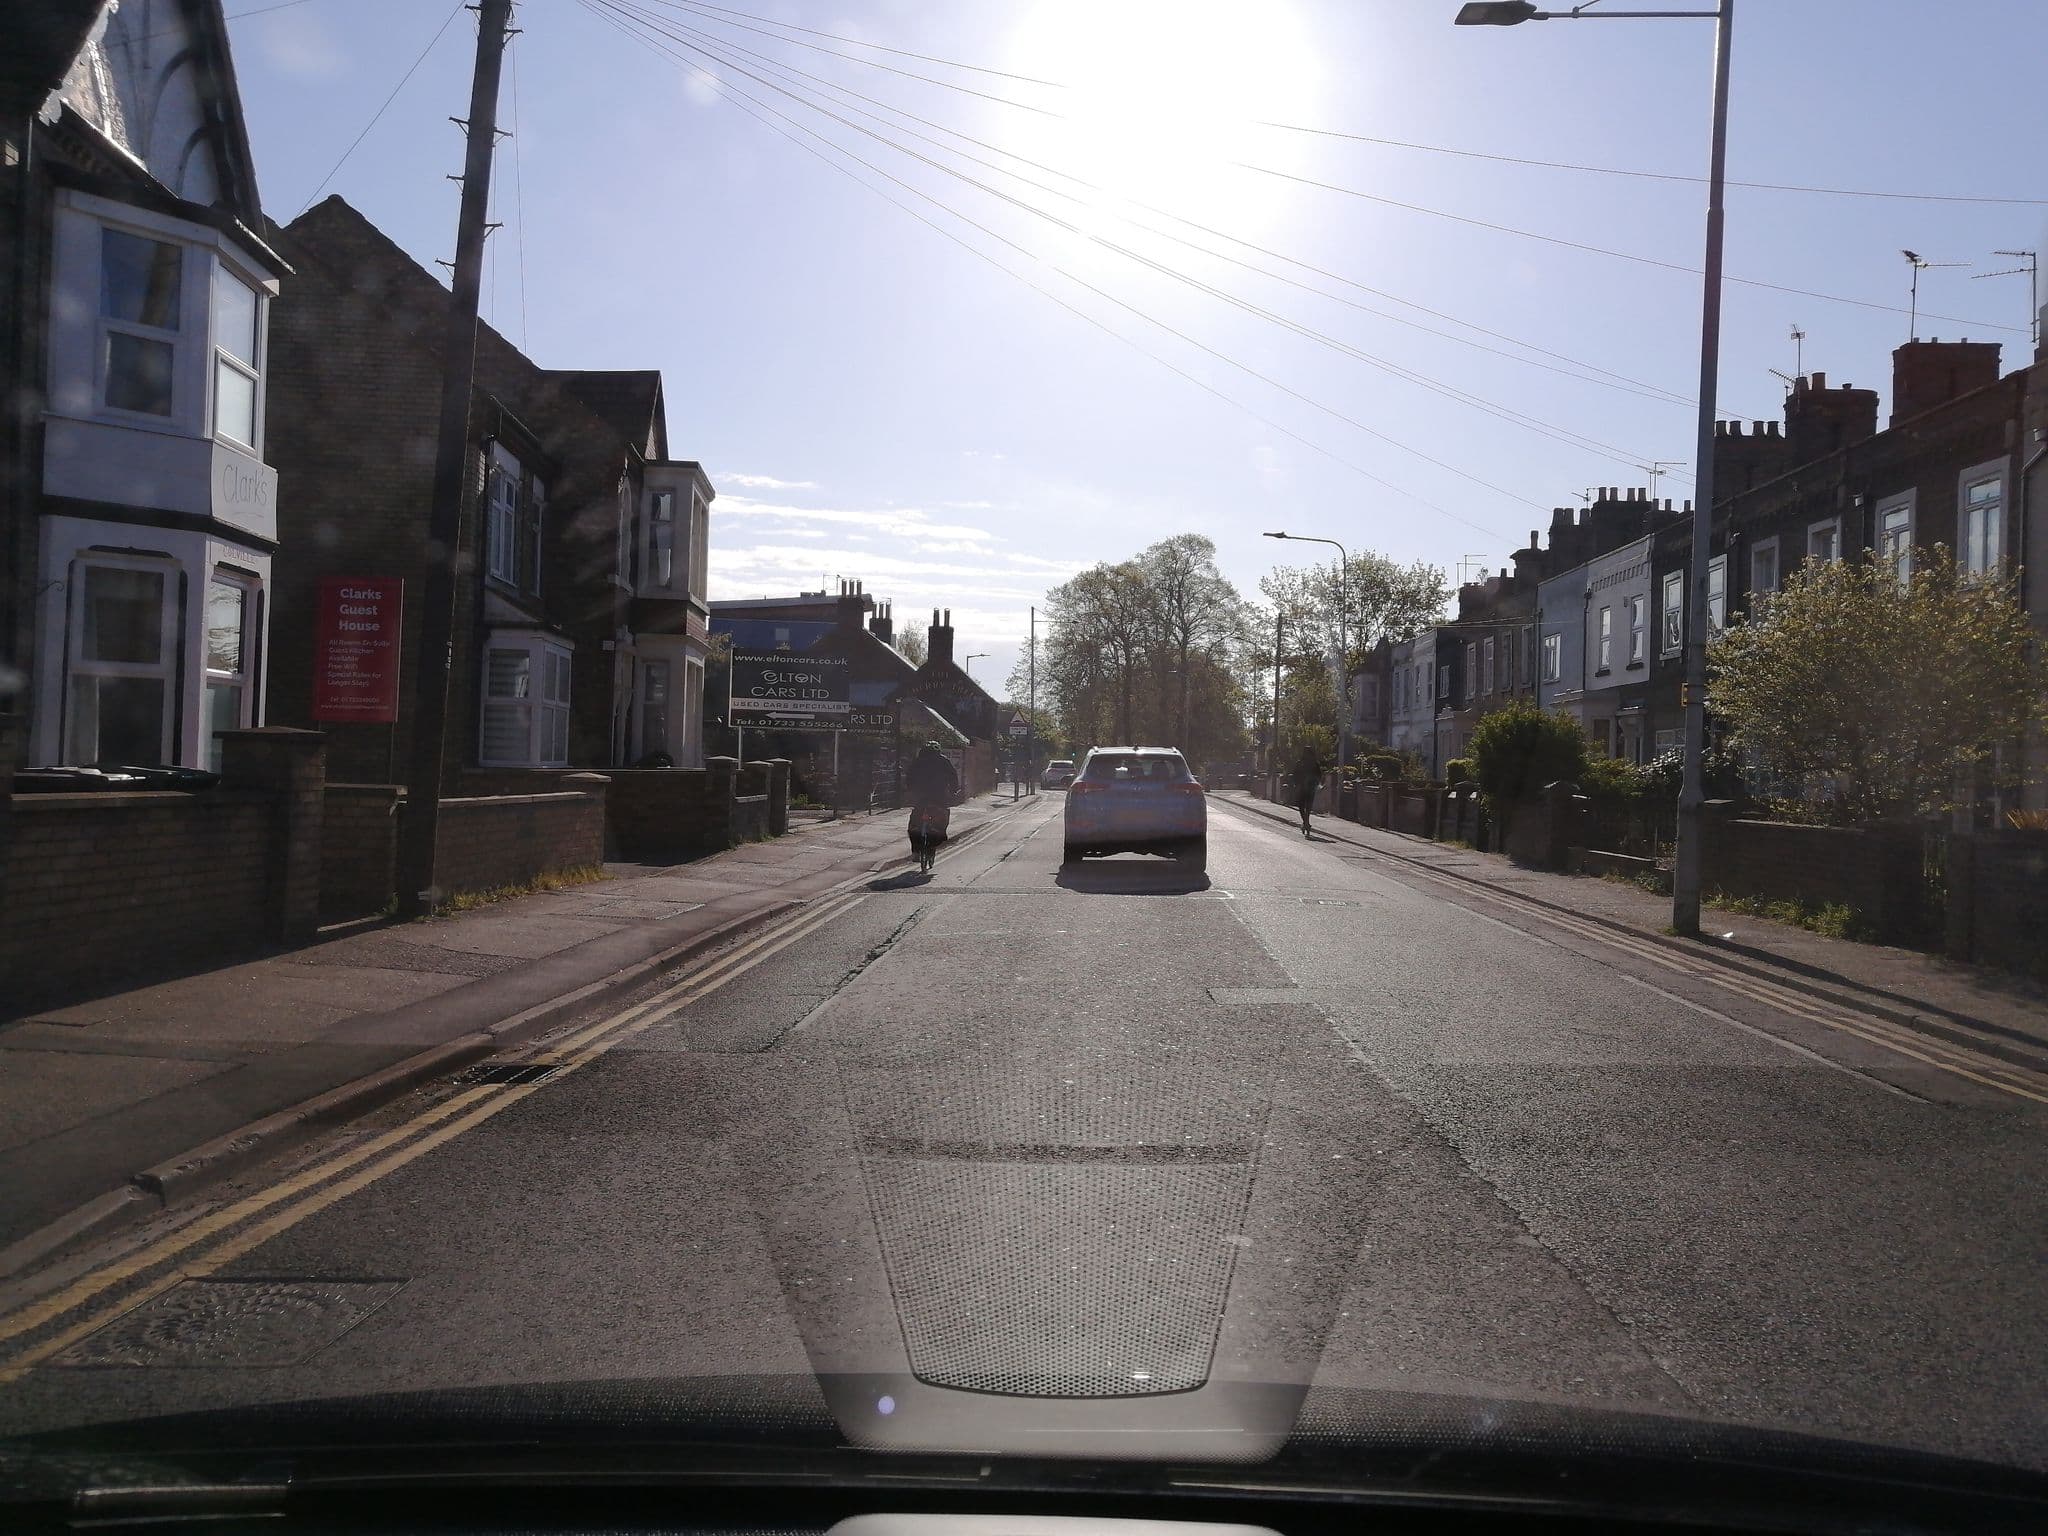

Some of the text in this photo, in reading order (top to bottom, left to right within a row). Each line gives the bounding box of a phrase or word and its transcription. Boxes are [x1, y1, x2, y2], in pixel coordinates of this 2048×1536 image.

[222, 464, 268, 506] Clark's
[339, 588, 383, 600] Clarks
[339, 603, 378, 615] Guest
[338, 620, 380, 631] House
[734, 655, 848, 666] www.eltoncars.co.uk
[751, 686, 830, 699] CARS LTD
[735, 718, 844, 729] Tel: 01733 555266
[849, 714, 893, 725] RS LTD
